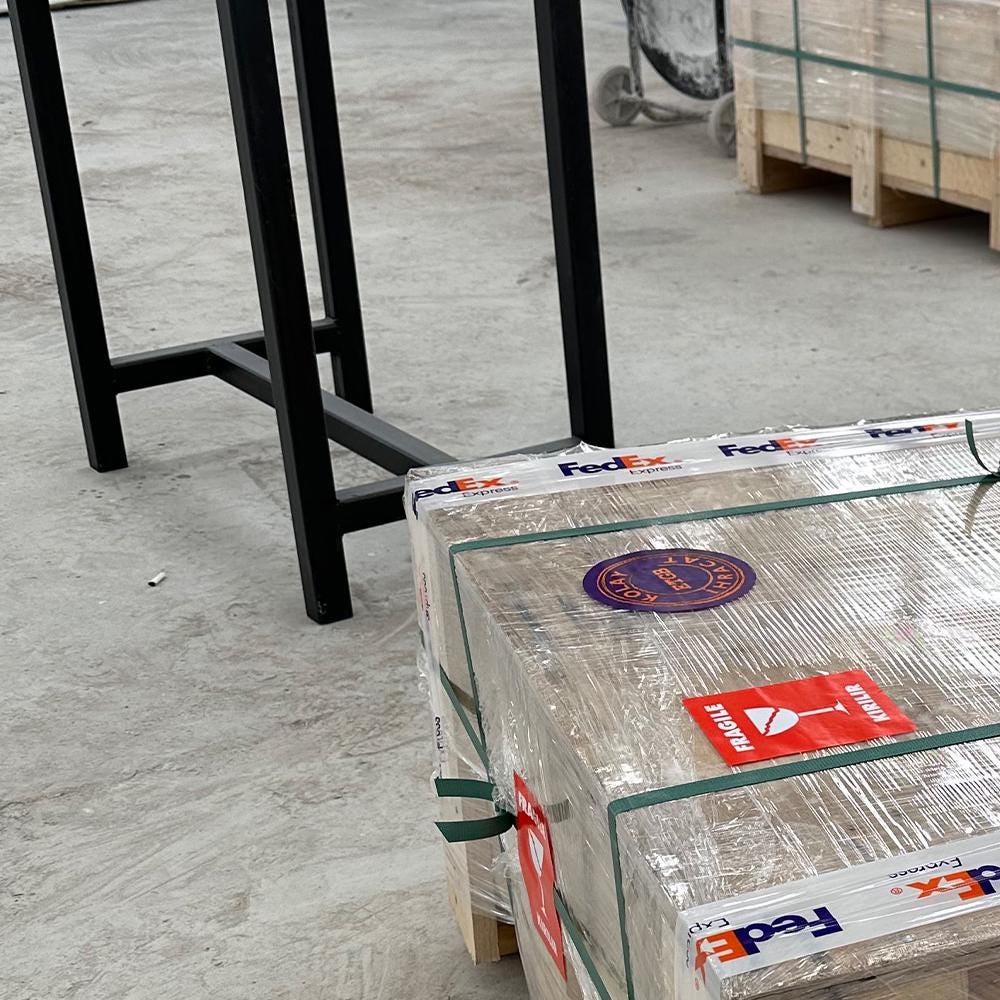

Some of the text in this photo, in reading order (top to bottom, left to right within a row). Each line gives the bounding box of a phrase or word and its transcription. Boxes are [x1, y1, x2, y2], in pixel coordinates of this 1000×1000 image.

[558, 455, 667, 477] FedEx
[629, 464, 683, 476] Express
[462, 485, 519, 498] Express
[609, 570, 658, 602] KOLAY
[652, 567, 692, 591] ETGB
[844, 683, 891, 723] KIRILIR
[704, 703, 755, 752] FRAGILE
